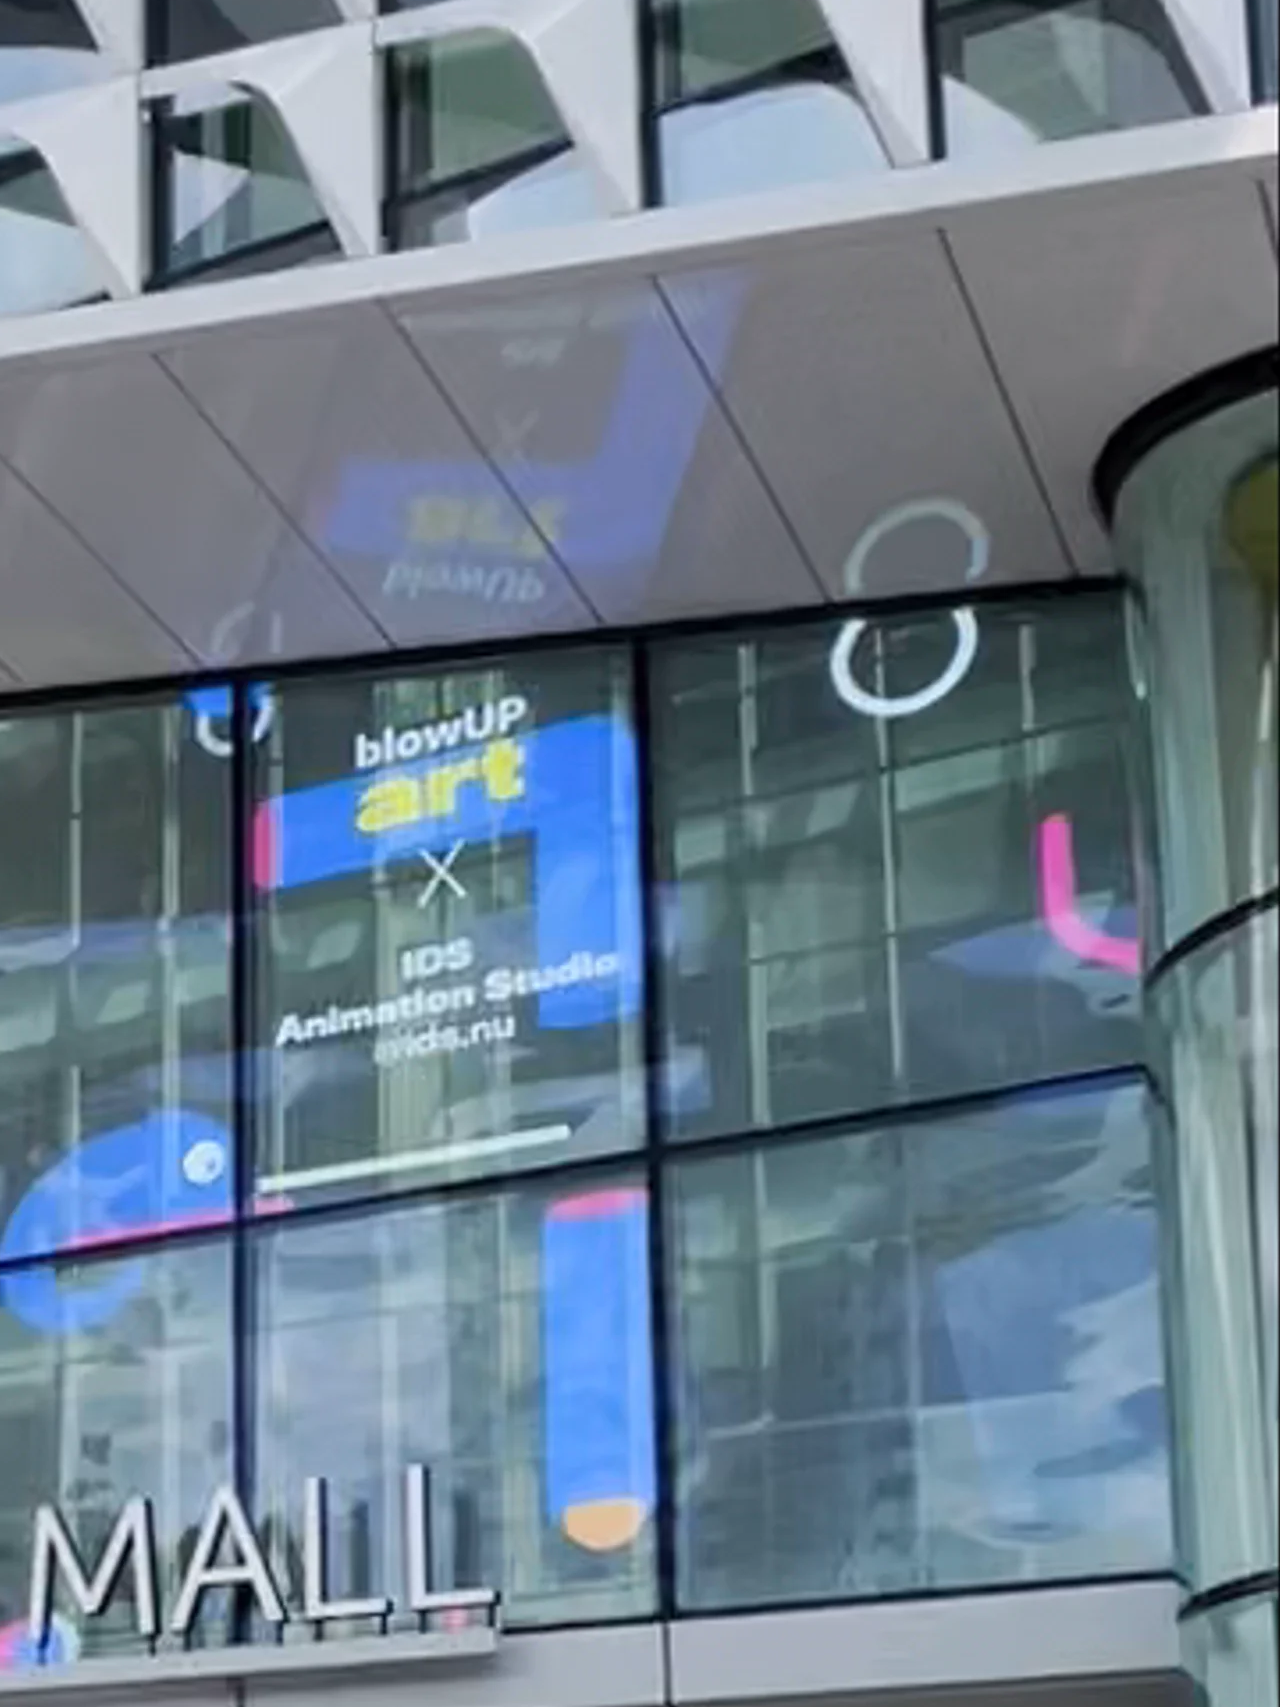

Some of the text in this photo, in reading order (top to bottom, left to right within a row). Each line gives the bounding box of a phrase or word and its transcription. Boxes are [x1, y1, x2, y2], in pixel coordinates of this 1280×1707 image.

[355, 696, 527, 768] blowUP
[355, 739, 526, 832] art
[275, 950, 620, 1047] Animation Studio
[401, 937, 474, 980] IDS
[28, 1462, 500, 1638] MALL
